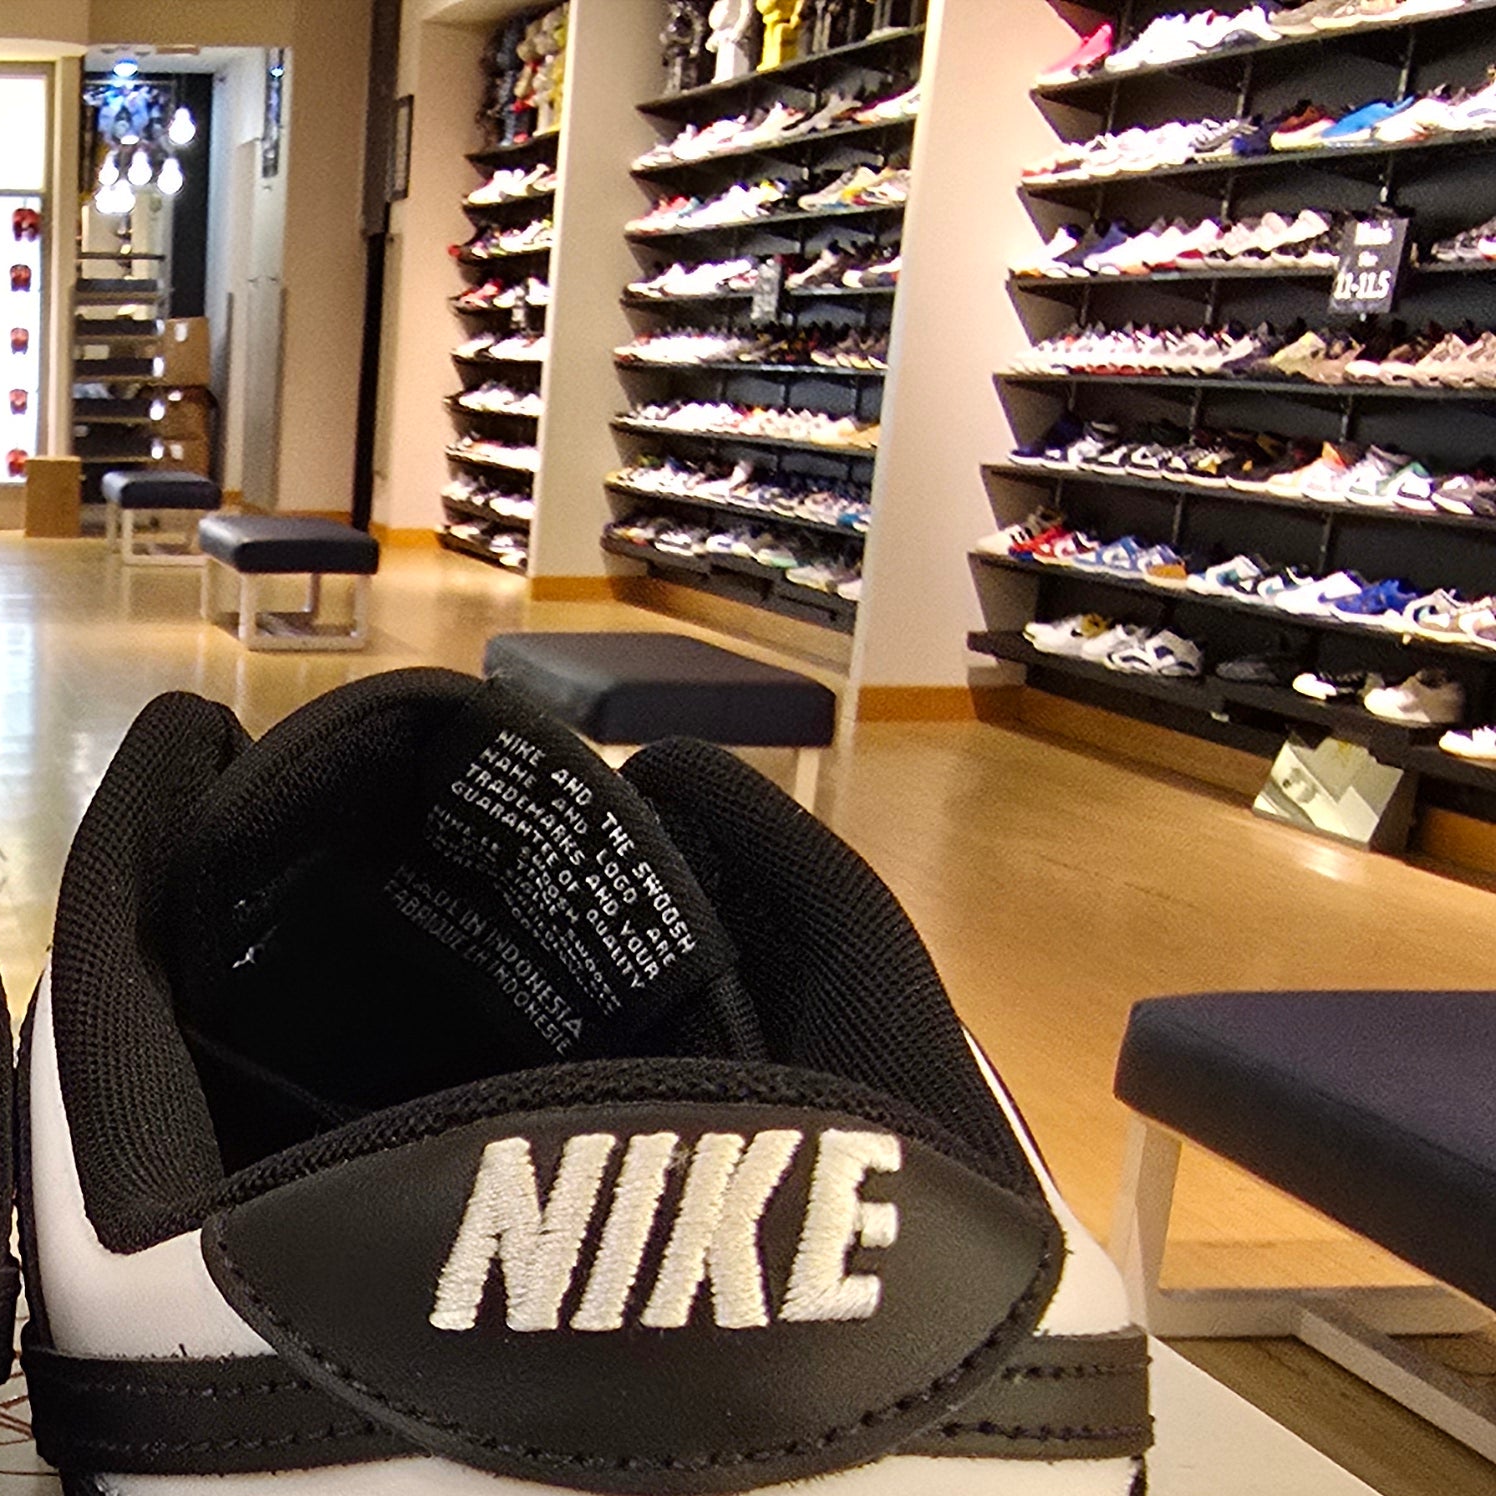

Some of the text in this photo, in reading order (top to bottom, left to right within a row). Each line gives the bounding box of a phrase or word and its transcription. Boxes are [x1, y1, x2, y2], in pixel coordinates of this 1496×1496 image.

[451, 780, 560, 867] GUARANTEE
[558, 869, 581, 893] OF
[586, 908, 646, 988] QUALITY
[466, 762, 586, 866] TRADEMARKS
[585, 874, 619, 917] AND
[620, 919, 660, 980] YOUR
[480, 747, 677, 967] NAME AND LOGO ARE
[495, 730, 696, 954] NIKE AND THE SWOOSH
[483, 927, 583, 1040] INDONESIA
[429, 1129, 901, 1332] NIKE
